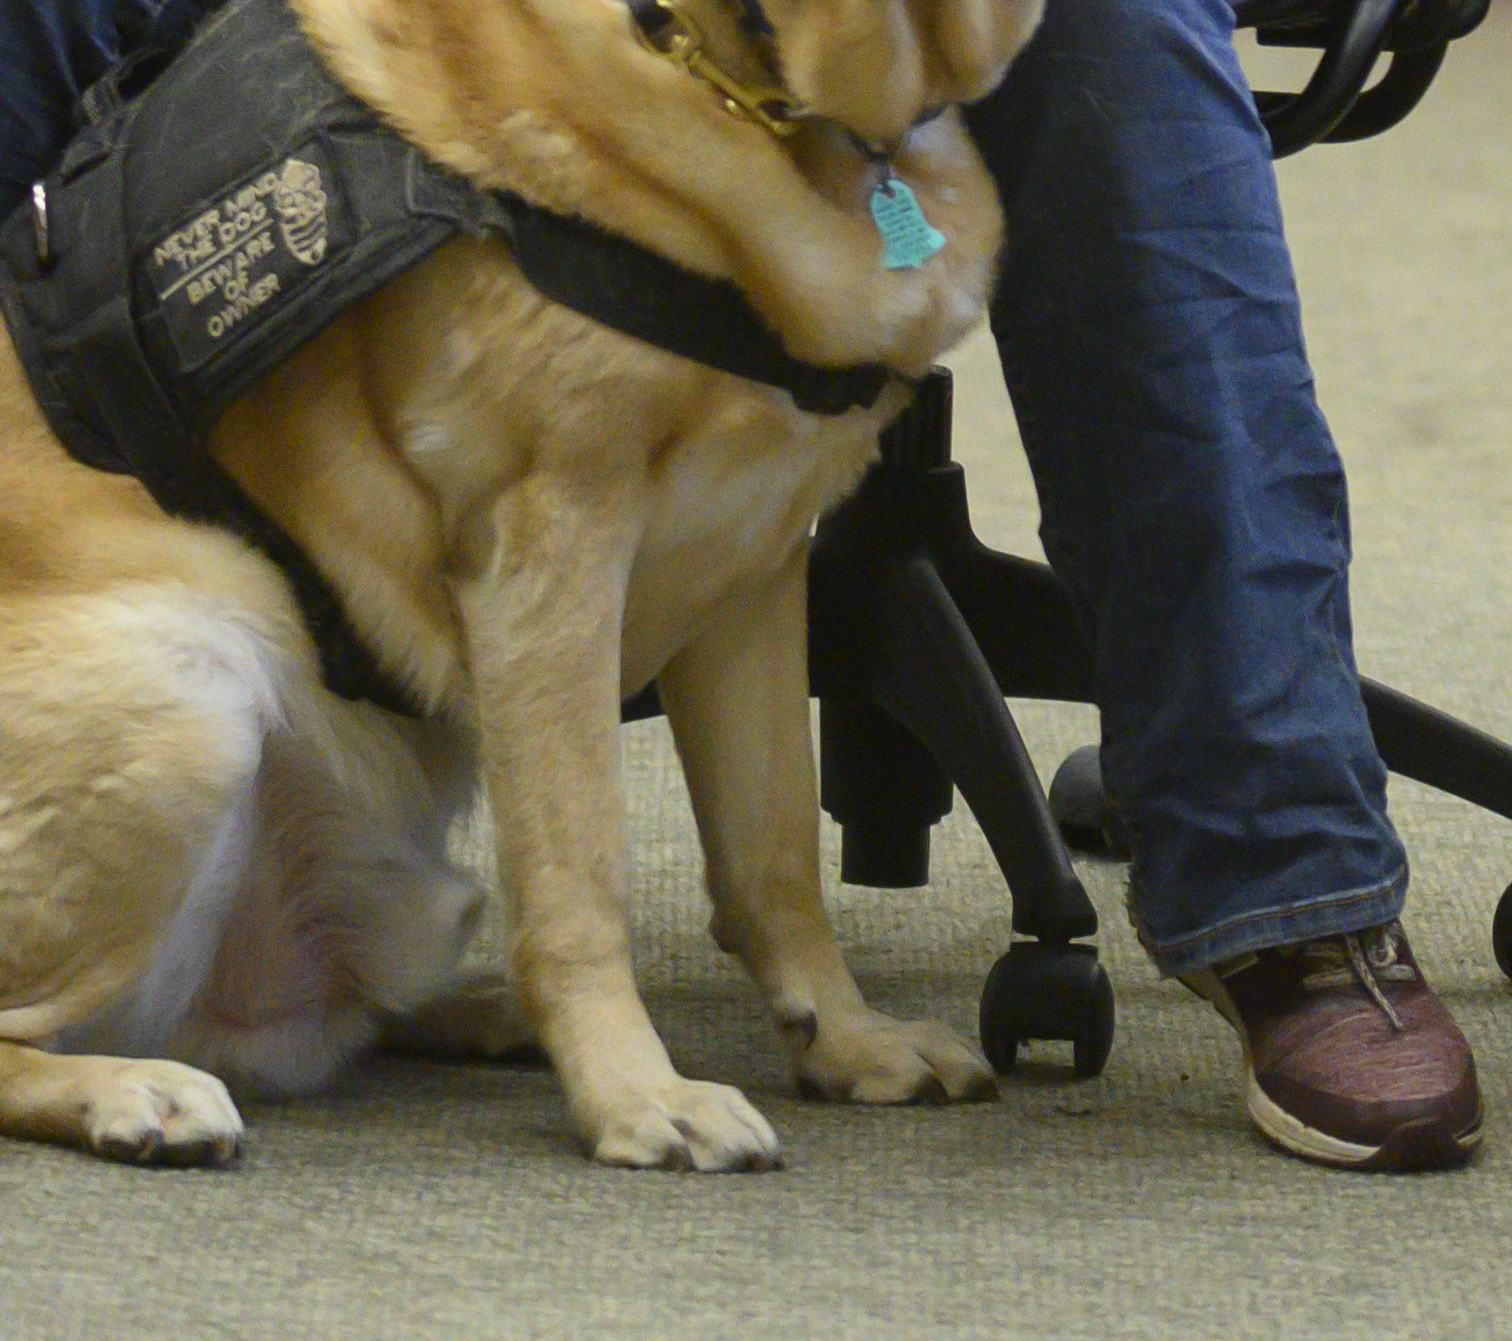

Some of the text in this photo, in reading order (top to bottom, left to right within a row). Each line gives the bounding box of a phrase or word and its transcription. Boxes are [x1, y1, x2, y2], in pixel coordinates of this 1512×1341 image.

[153, 208, 220, 268] NEVER
[219, 200, 268, 246] DOG
[187, 230, 277, 306] BEWARE
[224, 269, 250, 303] OF
[206, 272, 282, 339] OWNER
